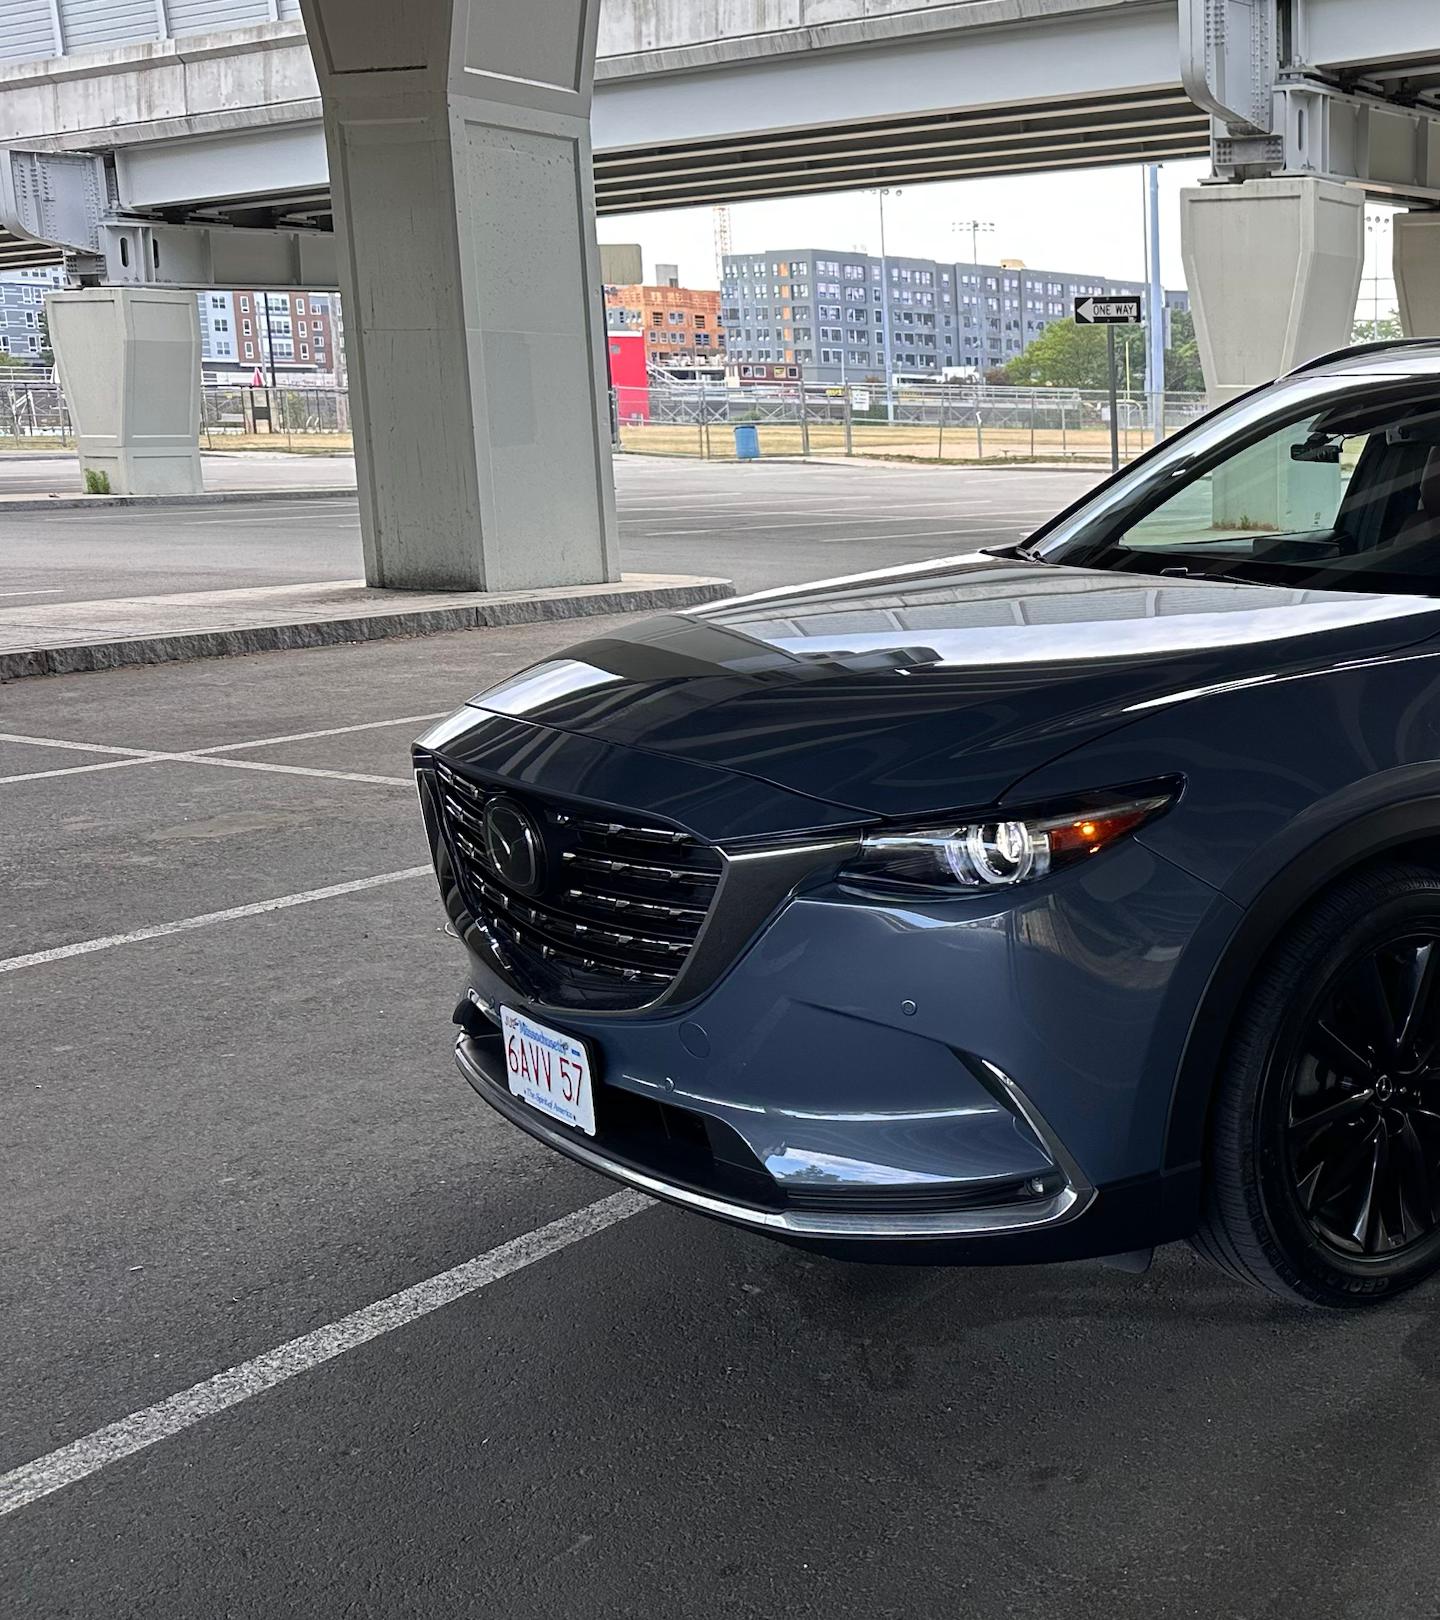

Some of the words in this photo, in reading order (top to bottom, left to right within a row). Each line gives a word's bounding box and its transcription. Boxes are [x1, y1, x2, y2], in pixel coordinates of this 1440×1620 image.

[1093, 304, 1111, 315] ONE
[1115, 304, 1134, 315] WAY
[508, 1035, 551, 1092] 6AVV
[559, 1056, 583, 1106] 57
